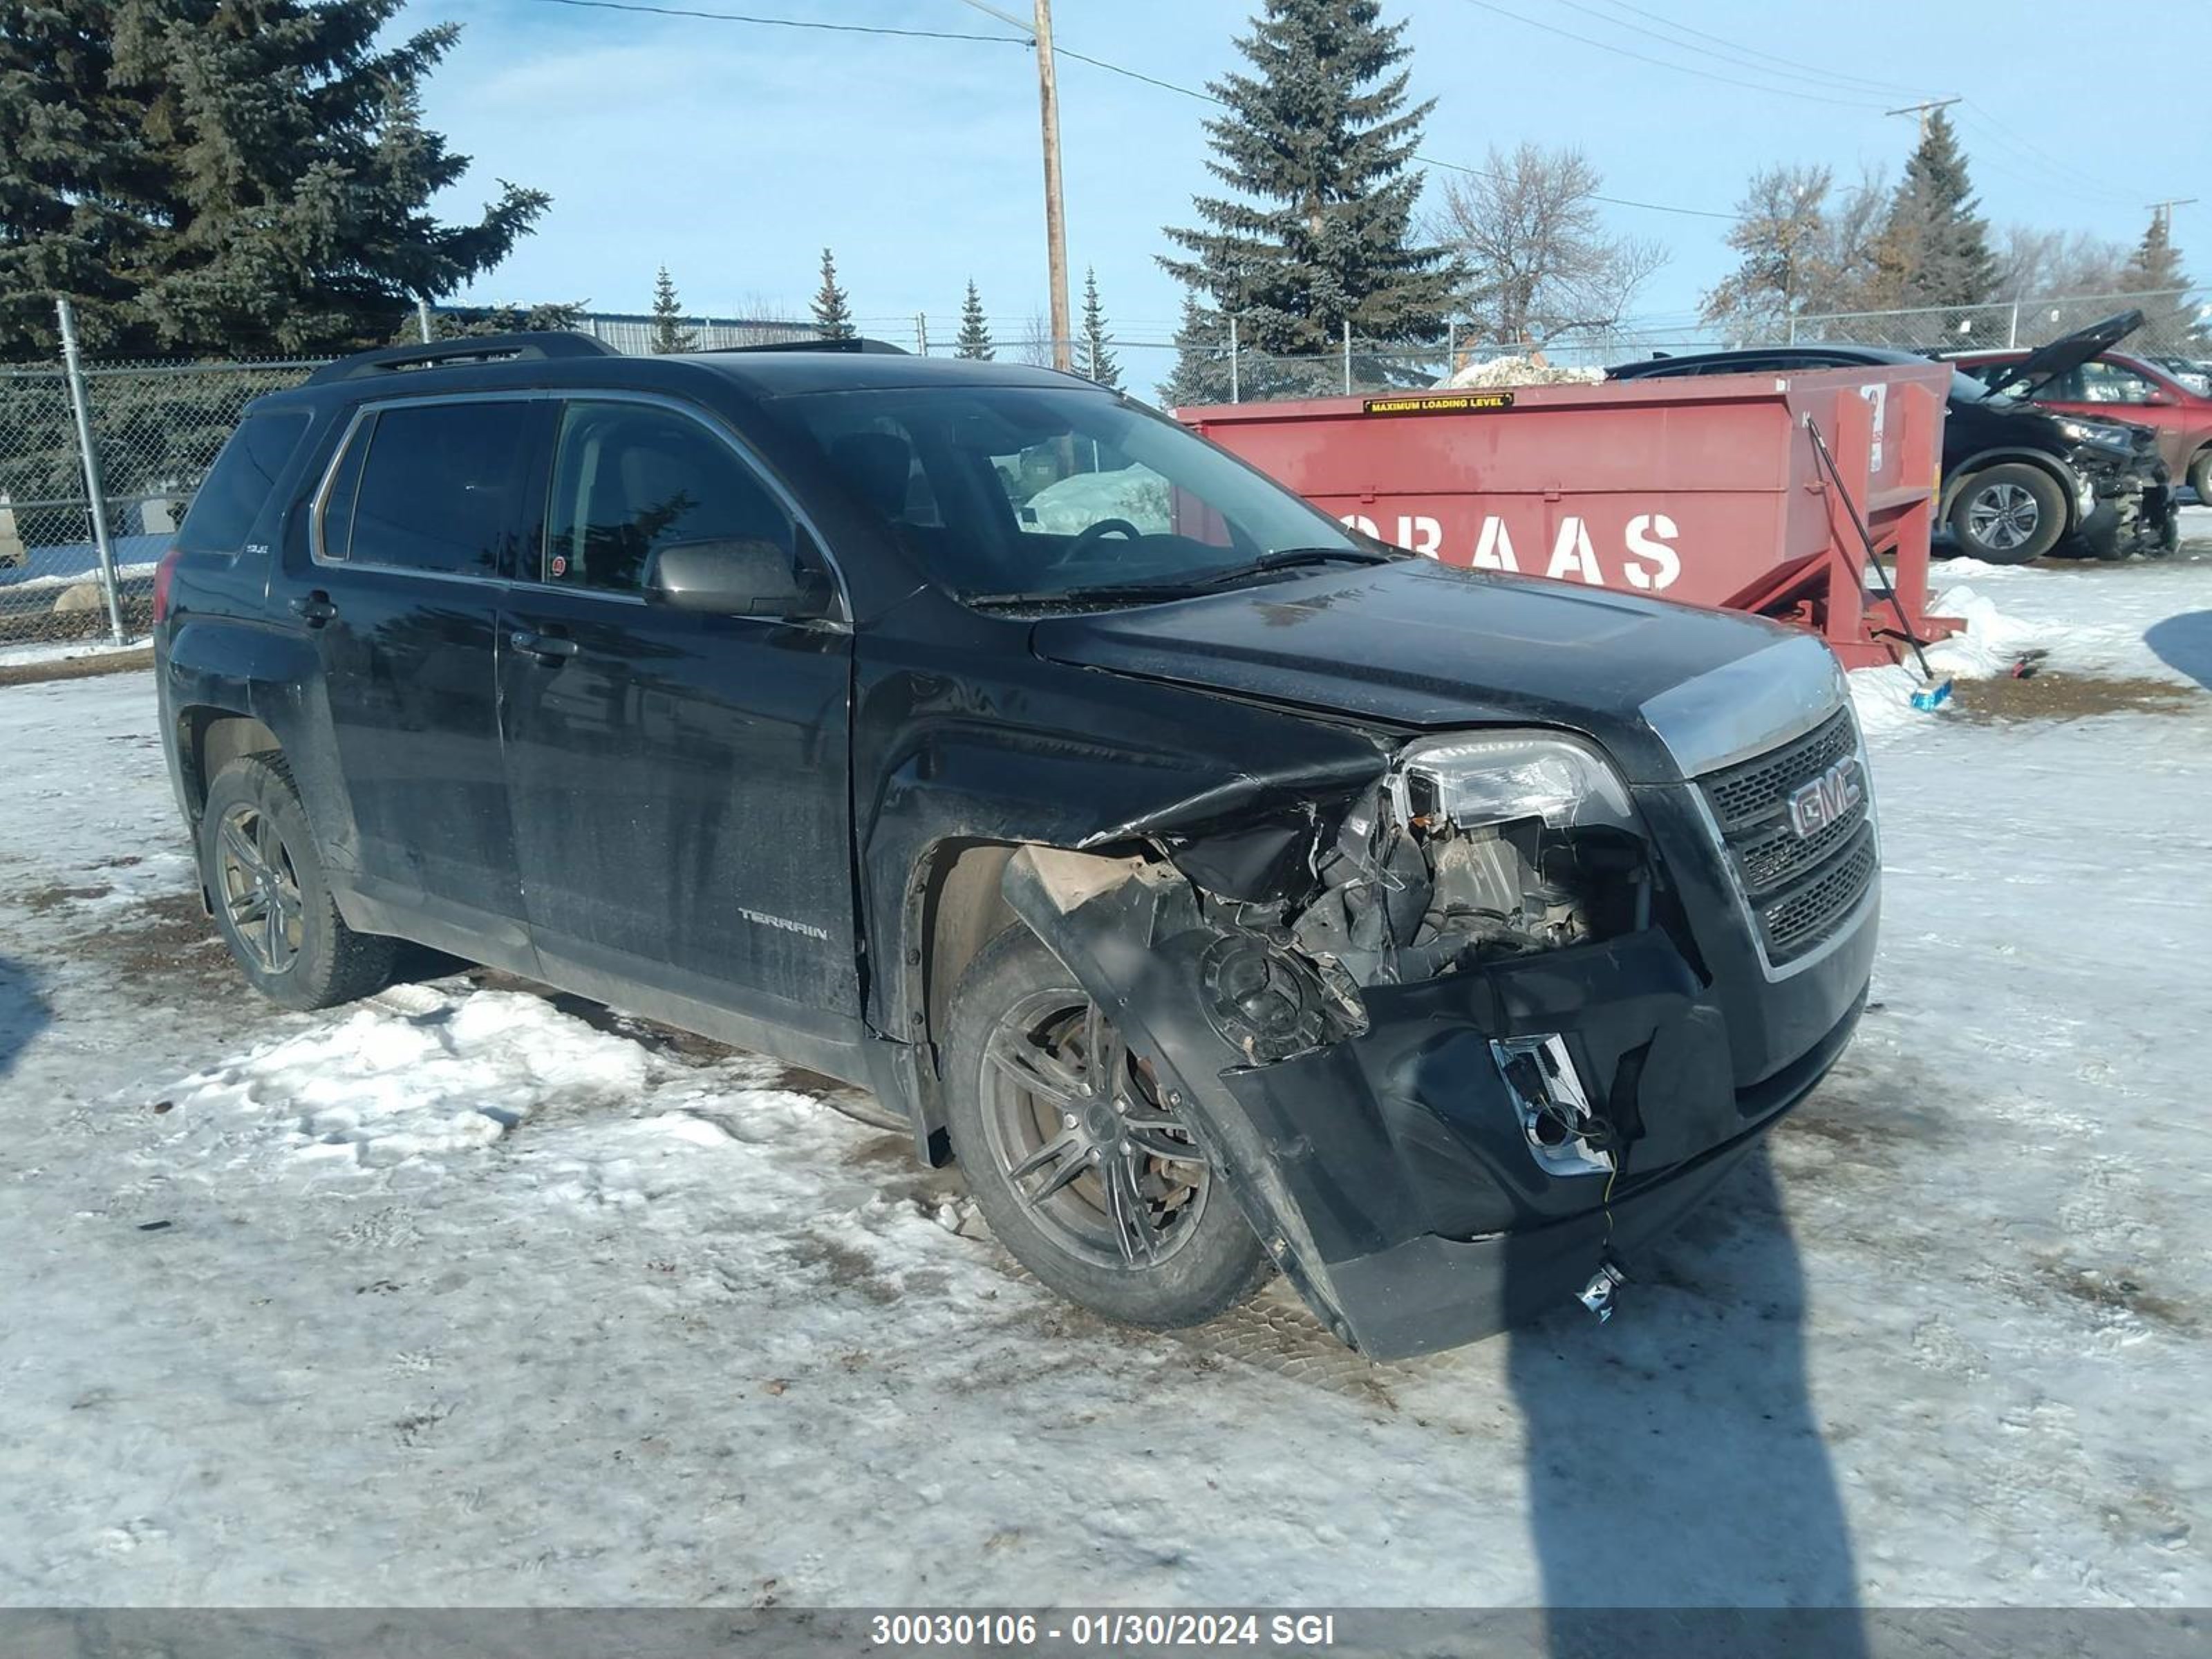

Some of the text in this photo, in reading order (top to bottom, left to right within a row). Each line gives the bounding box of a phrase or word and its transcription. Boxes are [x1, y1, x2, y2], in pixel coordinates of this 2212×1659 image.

[1371, 397, 1503, 413] MAXIMUM LOADING LEVEL
[1788, 756, 1861, 838] GMC
[737, 907, 828, 940] TERRAIN
